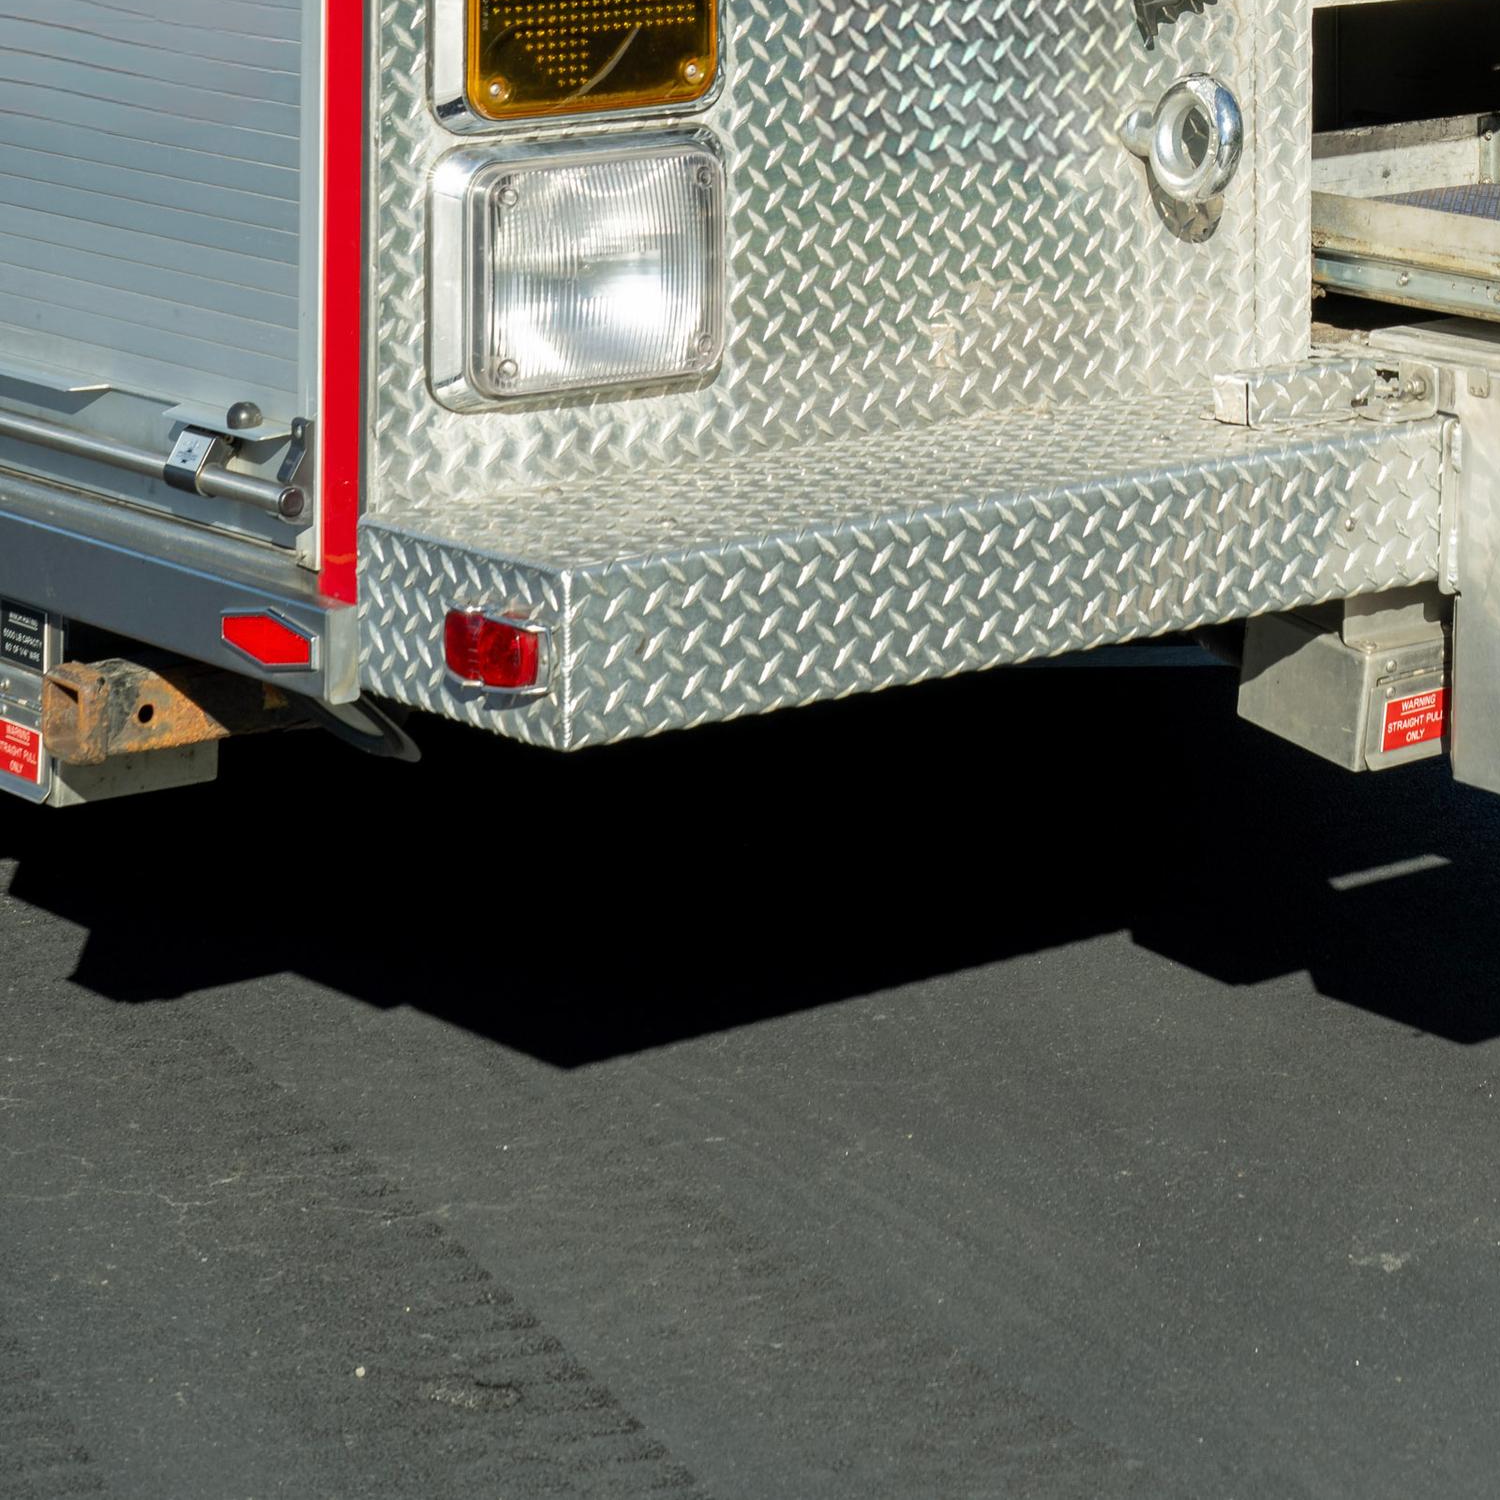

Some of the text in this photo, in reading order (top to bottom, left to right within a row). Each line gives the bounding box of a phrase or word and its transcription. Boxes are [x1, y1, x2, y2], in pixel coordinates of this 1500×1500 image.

[1401, 693, 1437, 712] WARNING
[1387, 713, 1424, 734] STRAIGHT
[1405, 727, 1425, 743] ONLY
